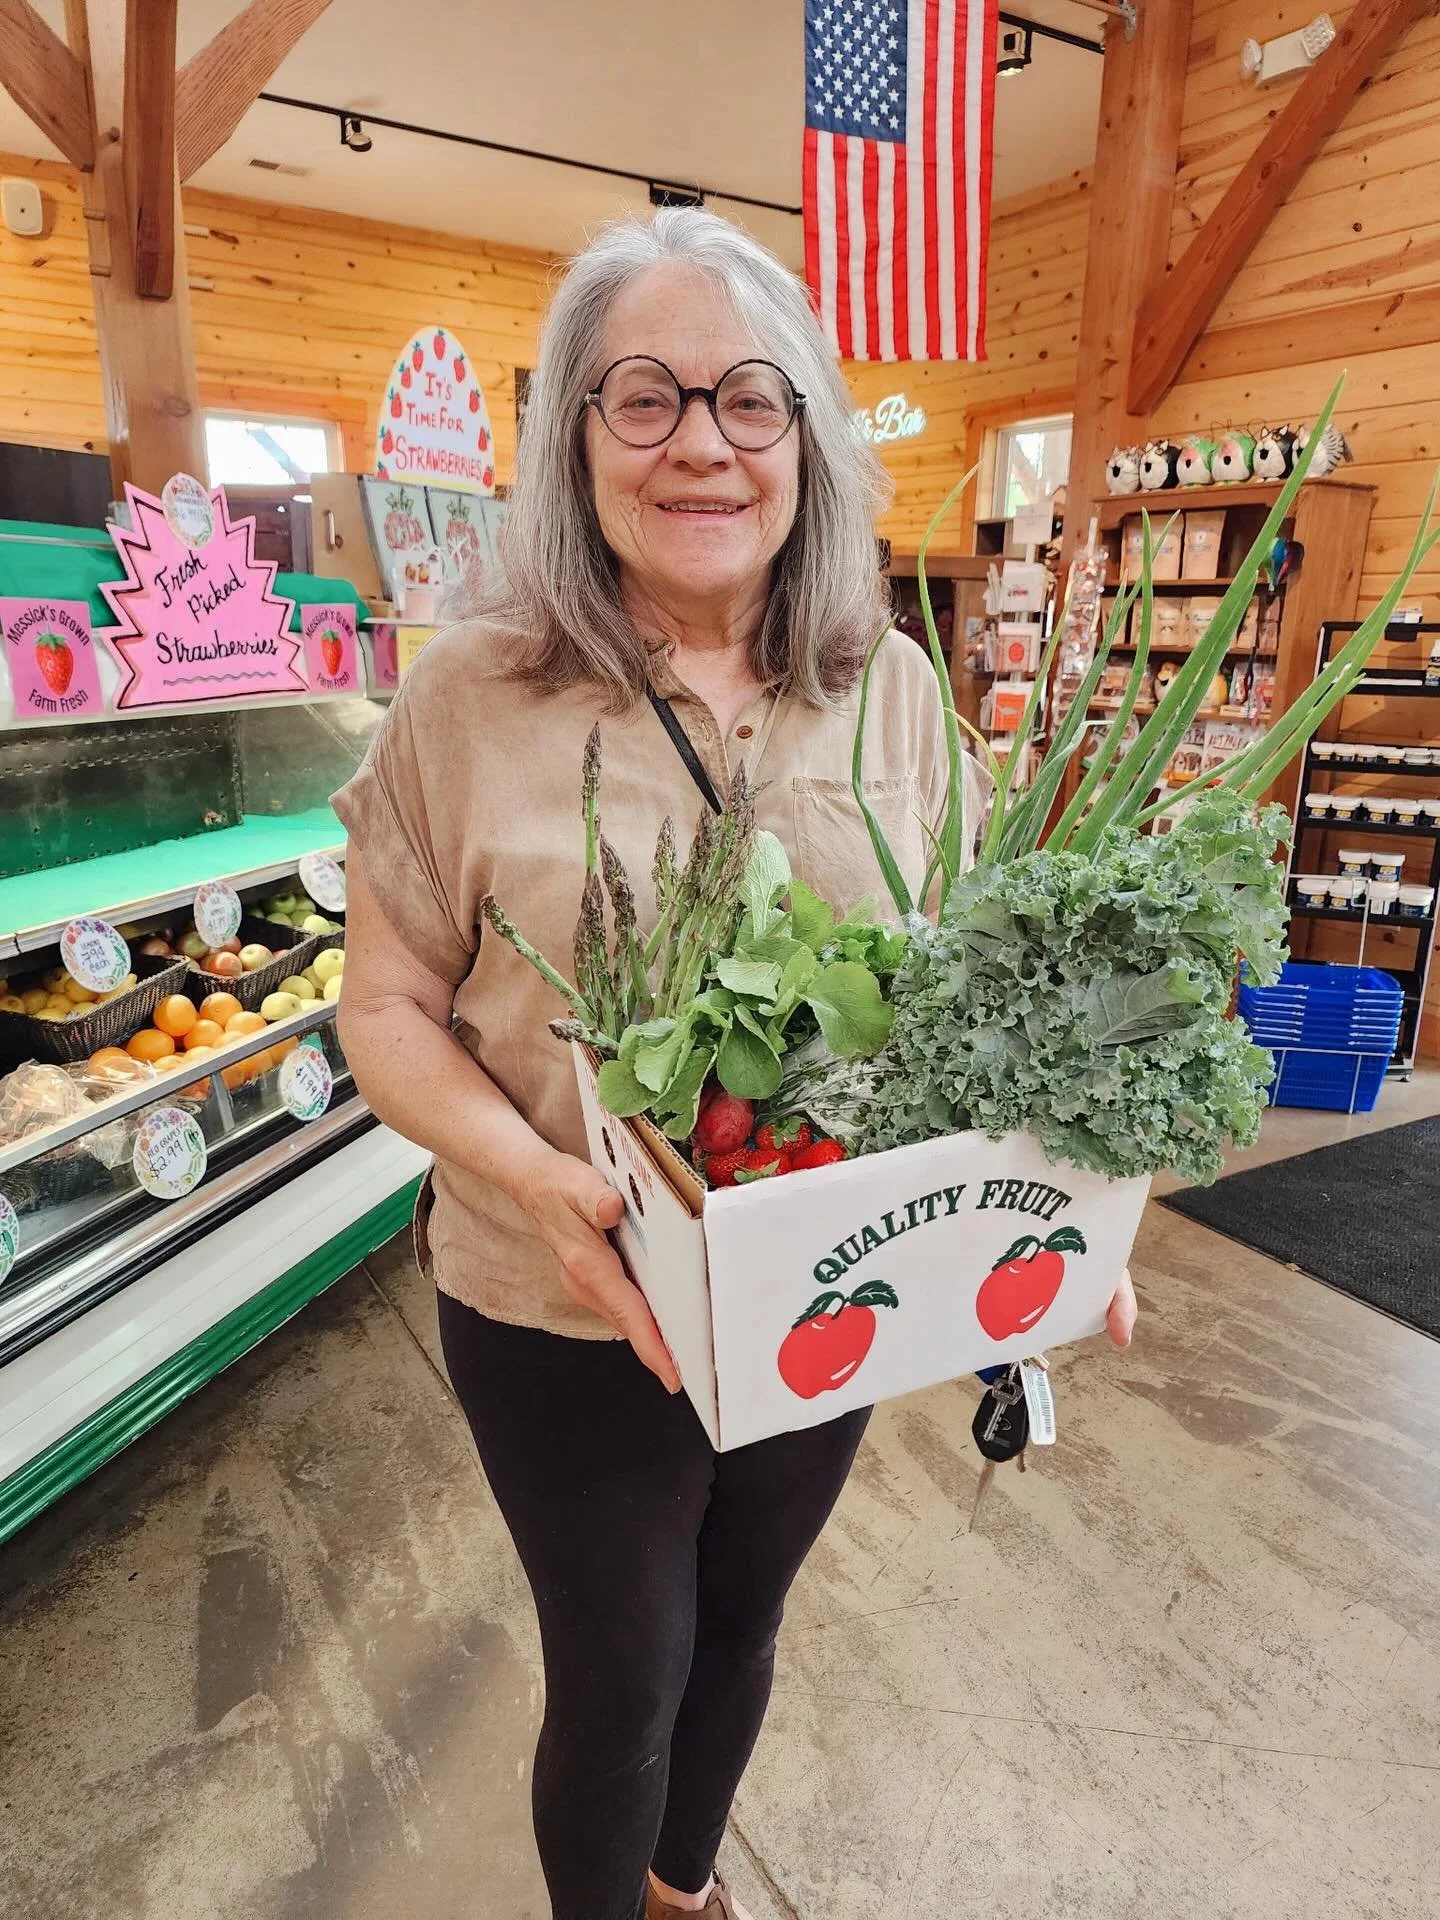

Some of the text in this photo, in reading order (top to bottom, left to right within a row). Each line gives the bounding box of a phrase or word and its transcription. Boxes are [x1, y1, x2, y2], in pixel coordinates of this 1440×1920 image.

[406, 402, 464, 434] TIME FOR
[395, 435, 482, 480] STRAWBERRIES
[154, 549, 208, 609] Fresh
[186, 563, 247, 624] Picked
[58, 610, 90, 646] Grown
[155, 630, 278, 664] Strawberries
[28, 688, 89, 713] Farm Fresh
[813, 1178, 1073, 1285] QUALITY FRUIT
